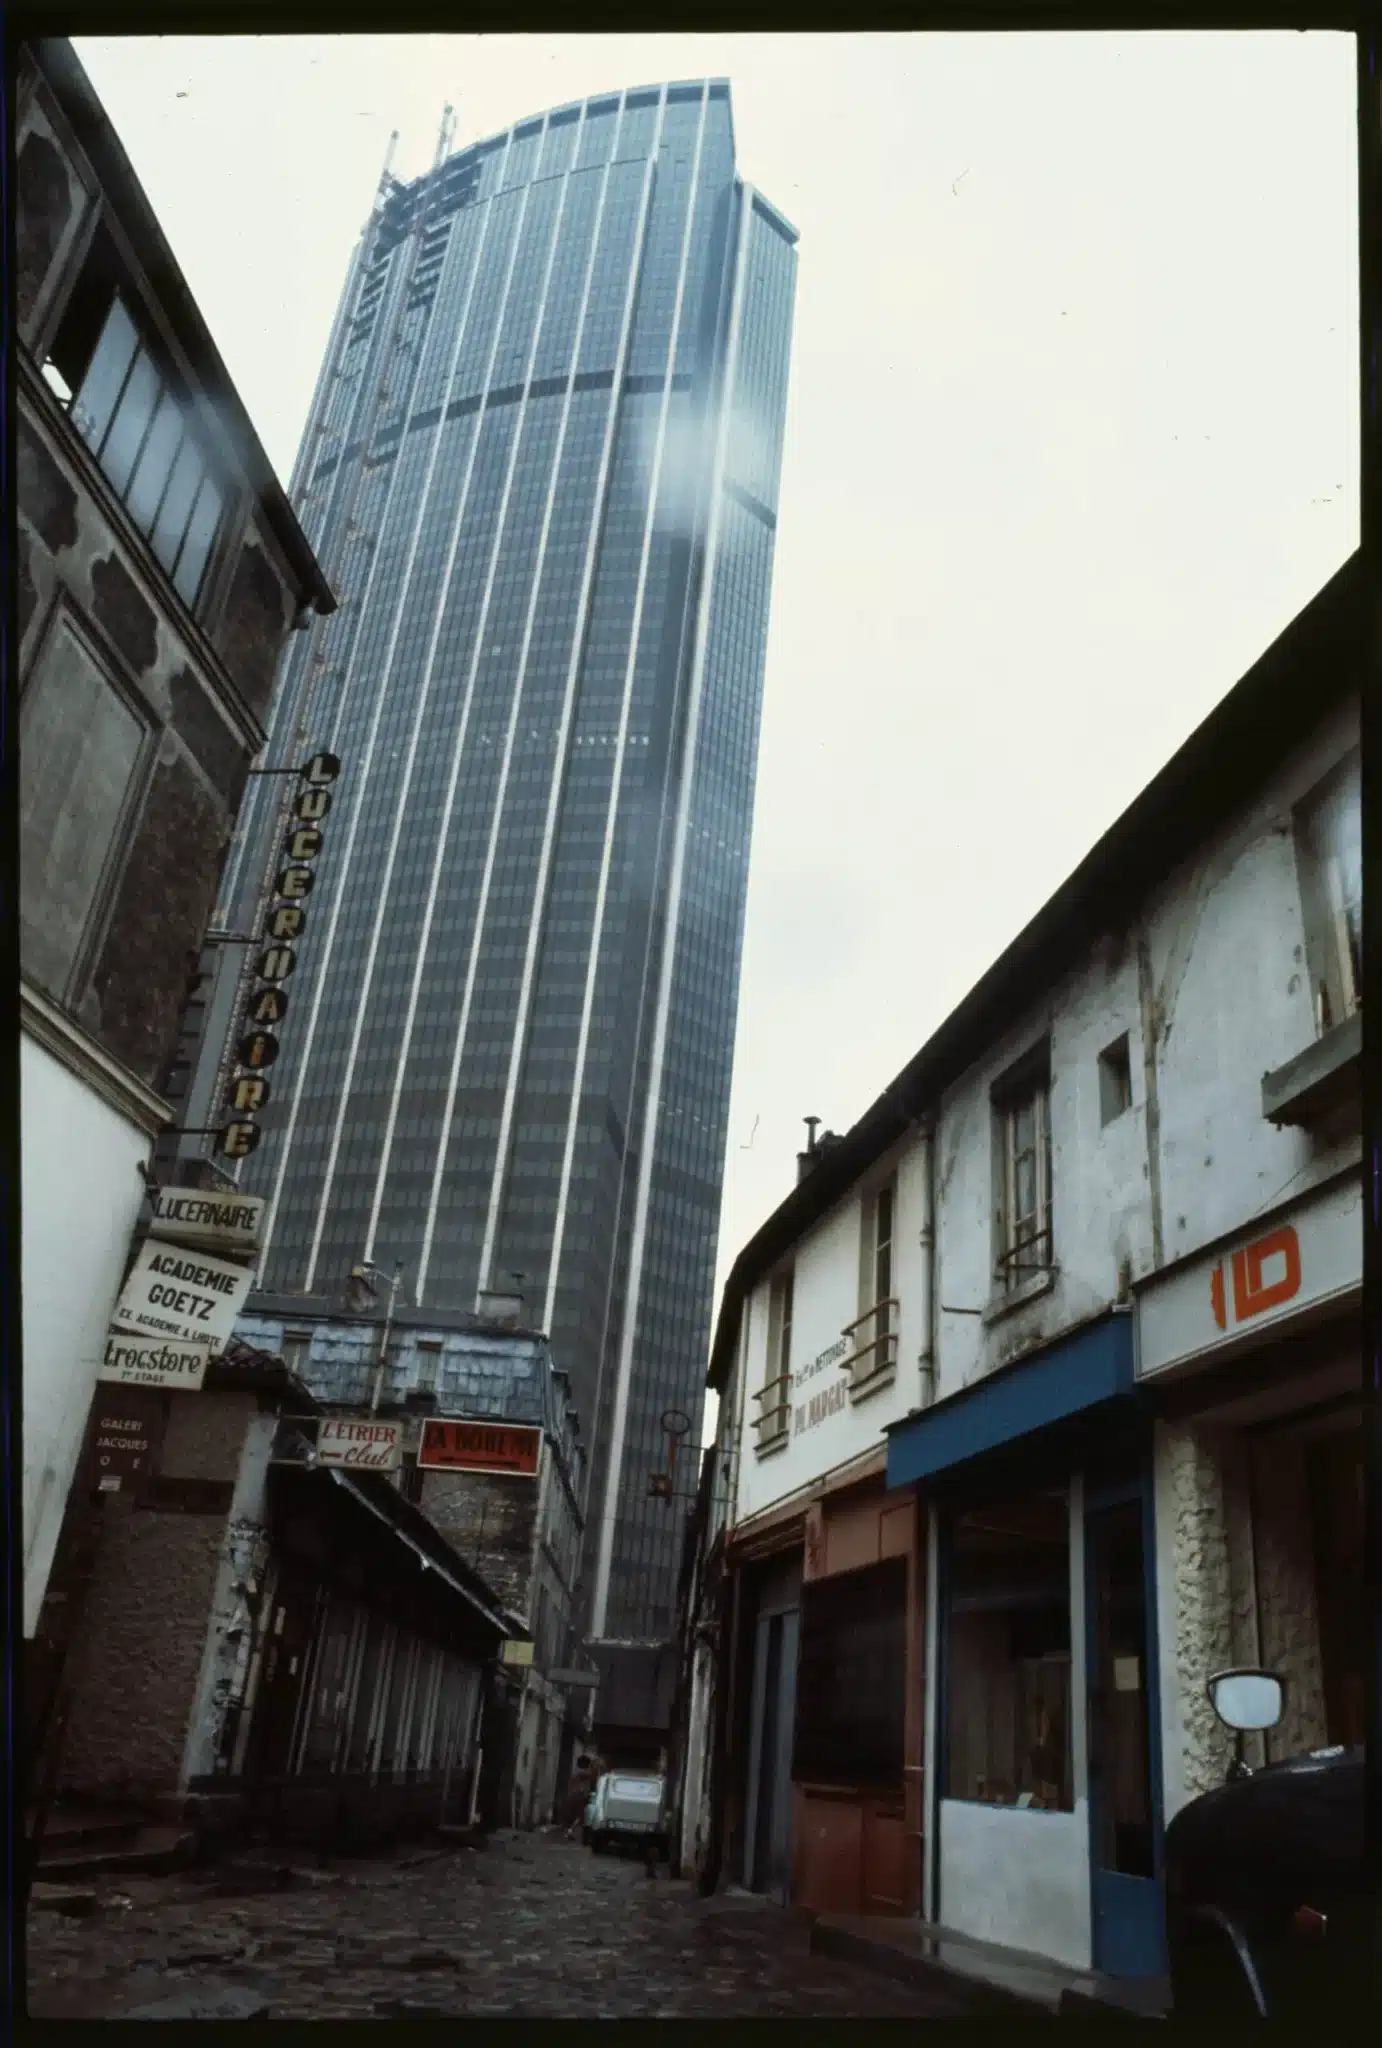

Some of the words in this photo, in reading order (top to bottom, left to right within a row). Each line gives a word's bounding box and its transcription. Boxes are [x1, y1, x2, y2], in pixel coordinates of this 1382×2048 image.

[223, 755, 338, 1157] LUCERNAIRE
[155, 1196, 259, 1230] LUCERNAIRE
[148, 1253, 239, 1295] ACADEMIE
[147, 1283, 216, 1321] GOETZ
[103, 1339, 201, 1374] trocstore
[96, 1437, 149, 1451] JACQUES
